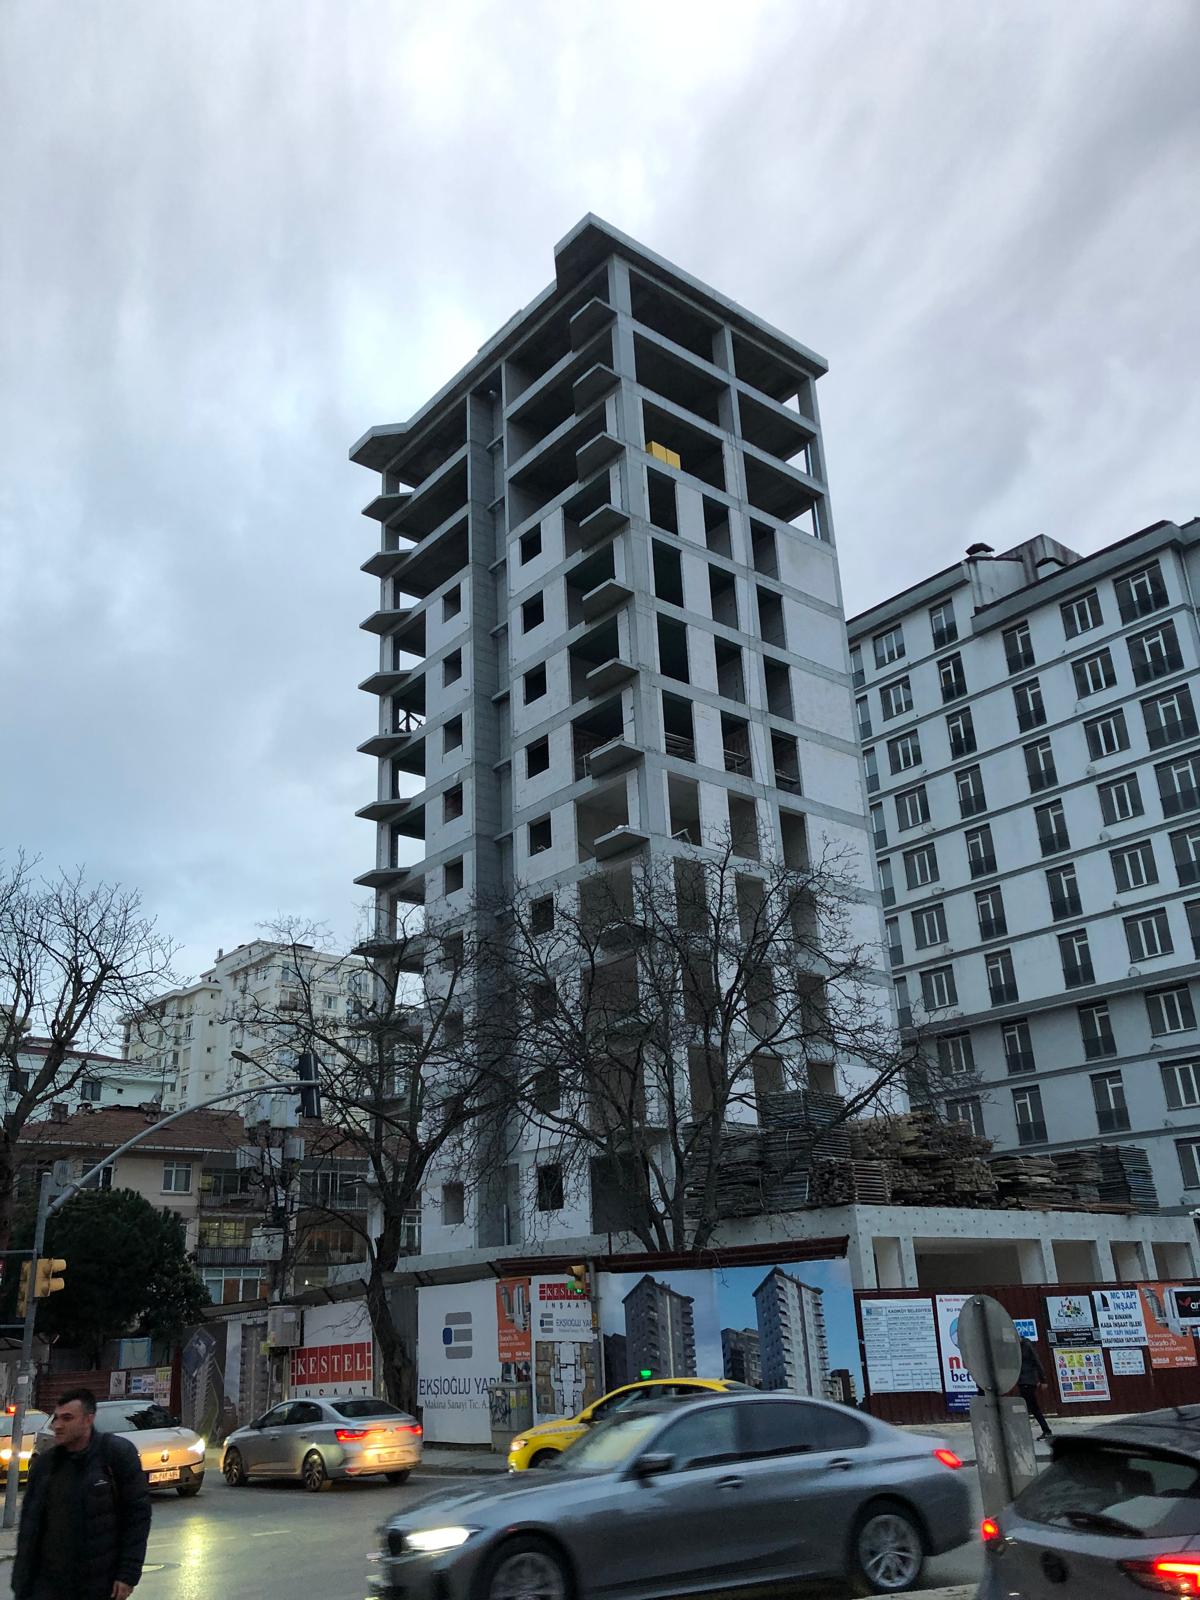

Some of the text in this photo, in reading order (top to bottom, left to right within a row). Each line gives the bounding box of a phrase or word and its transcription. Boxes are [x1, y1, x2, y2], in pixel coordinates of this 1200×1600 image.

[546, 1287, 584, 1297] KESTE
[1110, 1292, 1120, 1300] MC
[1113, 1302, 1137, 1311] İNŞAAT
[297, 1353, 365, 1376] KESTEL
[950, 1370, 973, 1383] bet
[419, 1376, 500, 1398] EKŞİOĞLU YA
